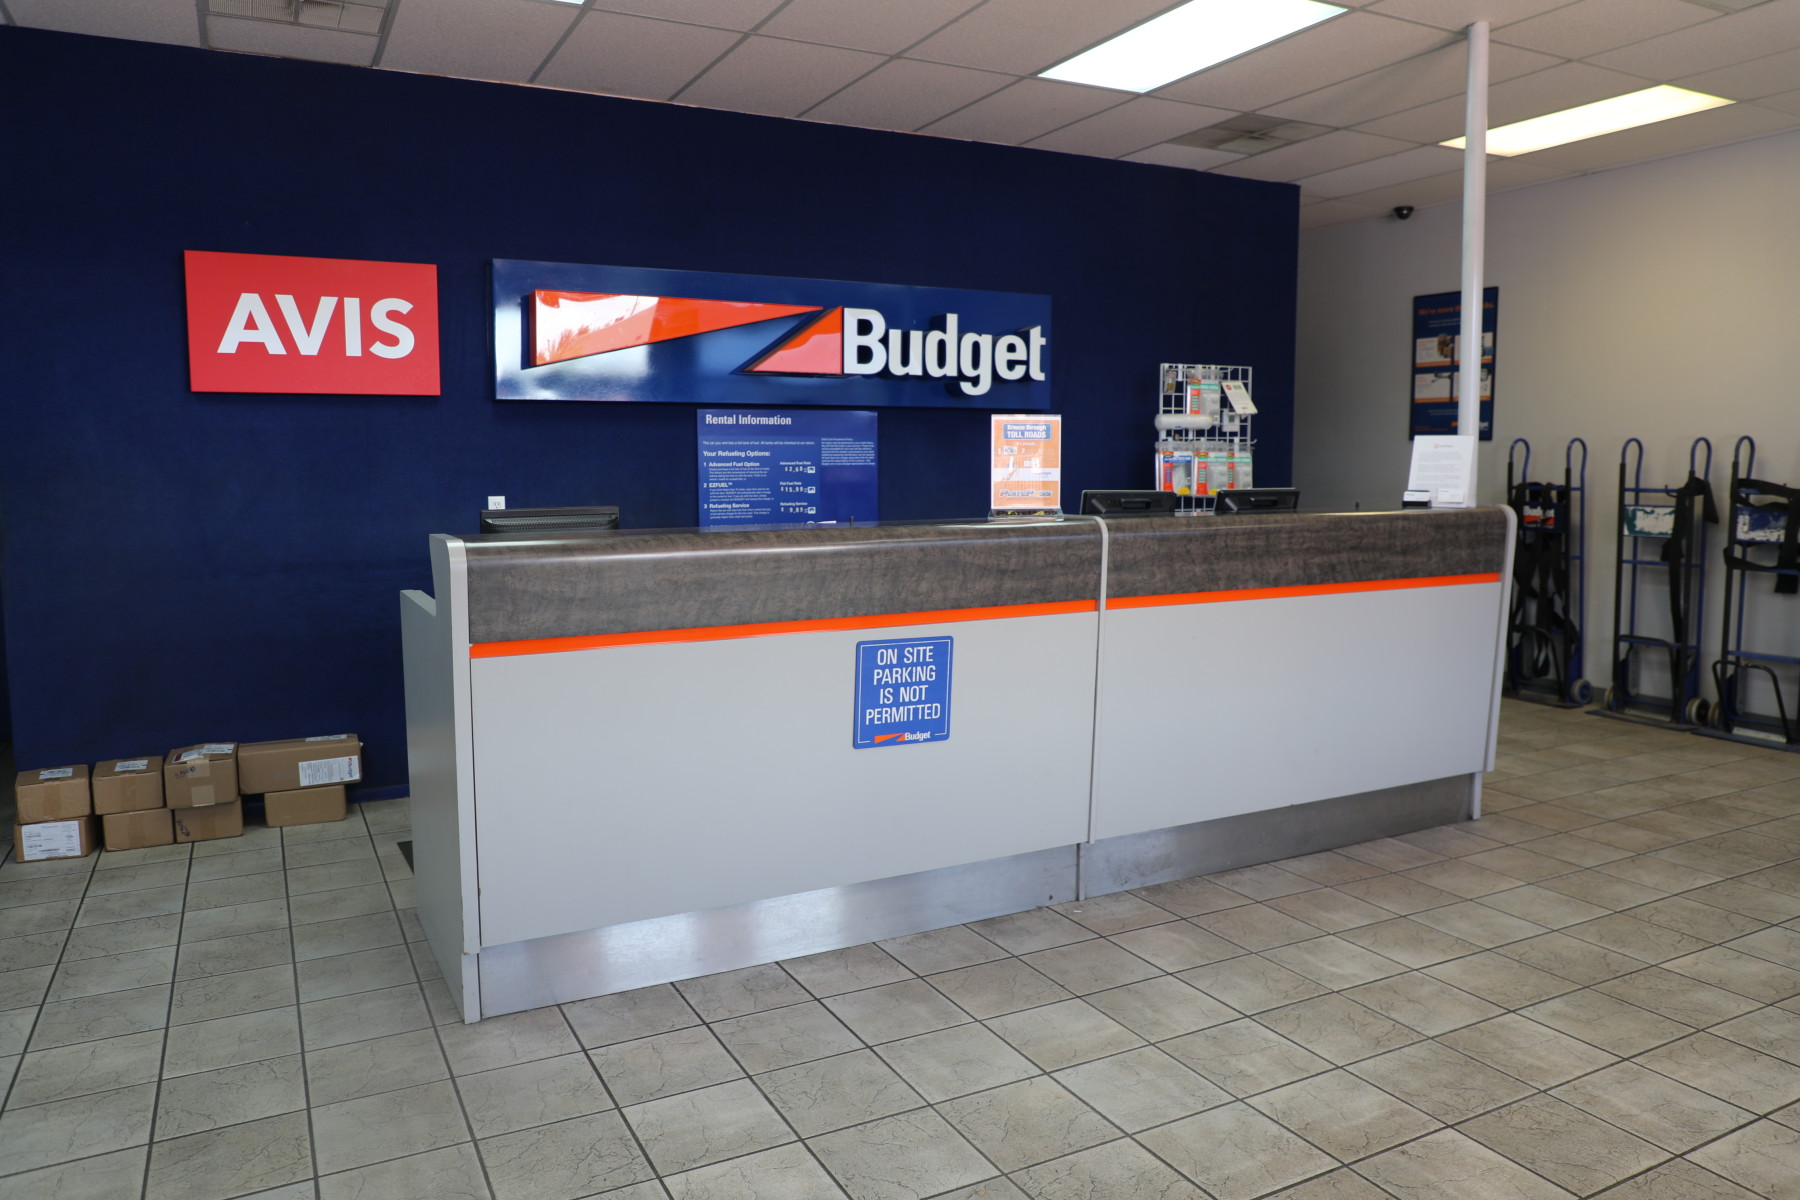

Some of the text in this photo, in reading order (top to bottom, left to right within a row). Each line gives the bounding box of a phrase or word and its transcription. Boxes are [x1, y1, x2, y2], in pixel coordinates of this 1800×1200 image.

[217, 293, 415, 359] AVIS
[844, 307, 1046, 396] Budget
[705, 414, 792, 425] Rental Information
[877, 646, 934, 665] ON SITE
[874, 665, 936, 685] PARKING
[880, 685, 928, 704] IS NOT
[866, 703, 940, 725] PERMITTED
[905, 731, 931, 741] Budget
